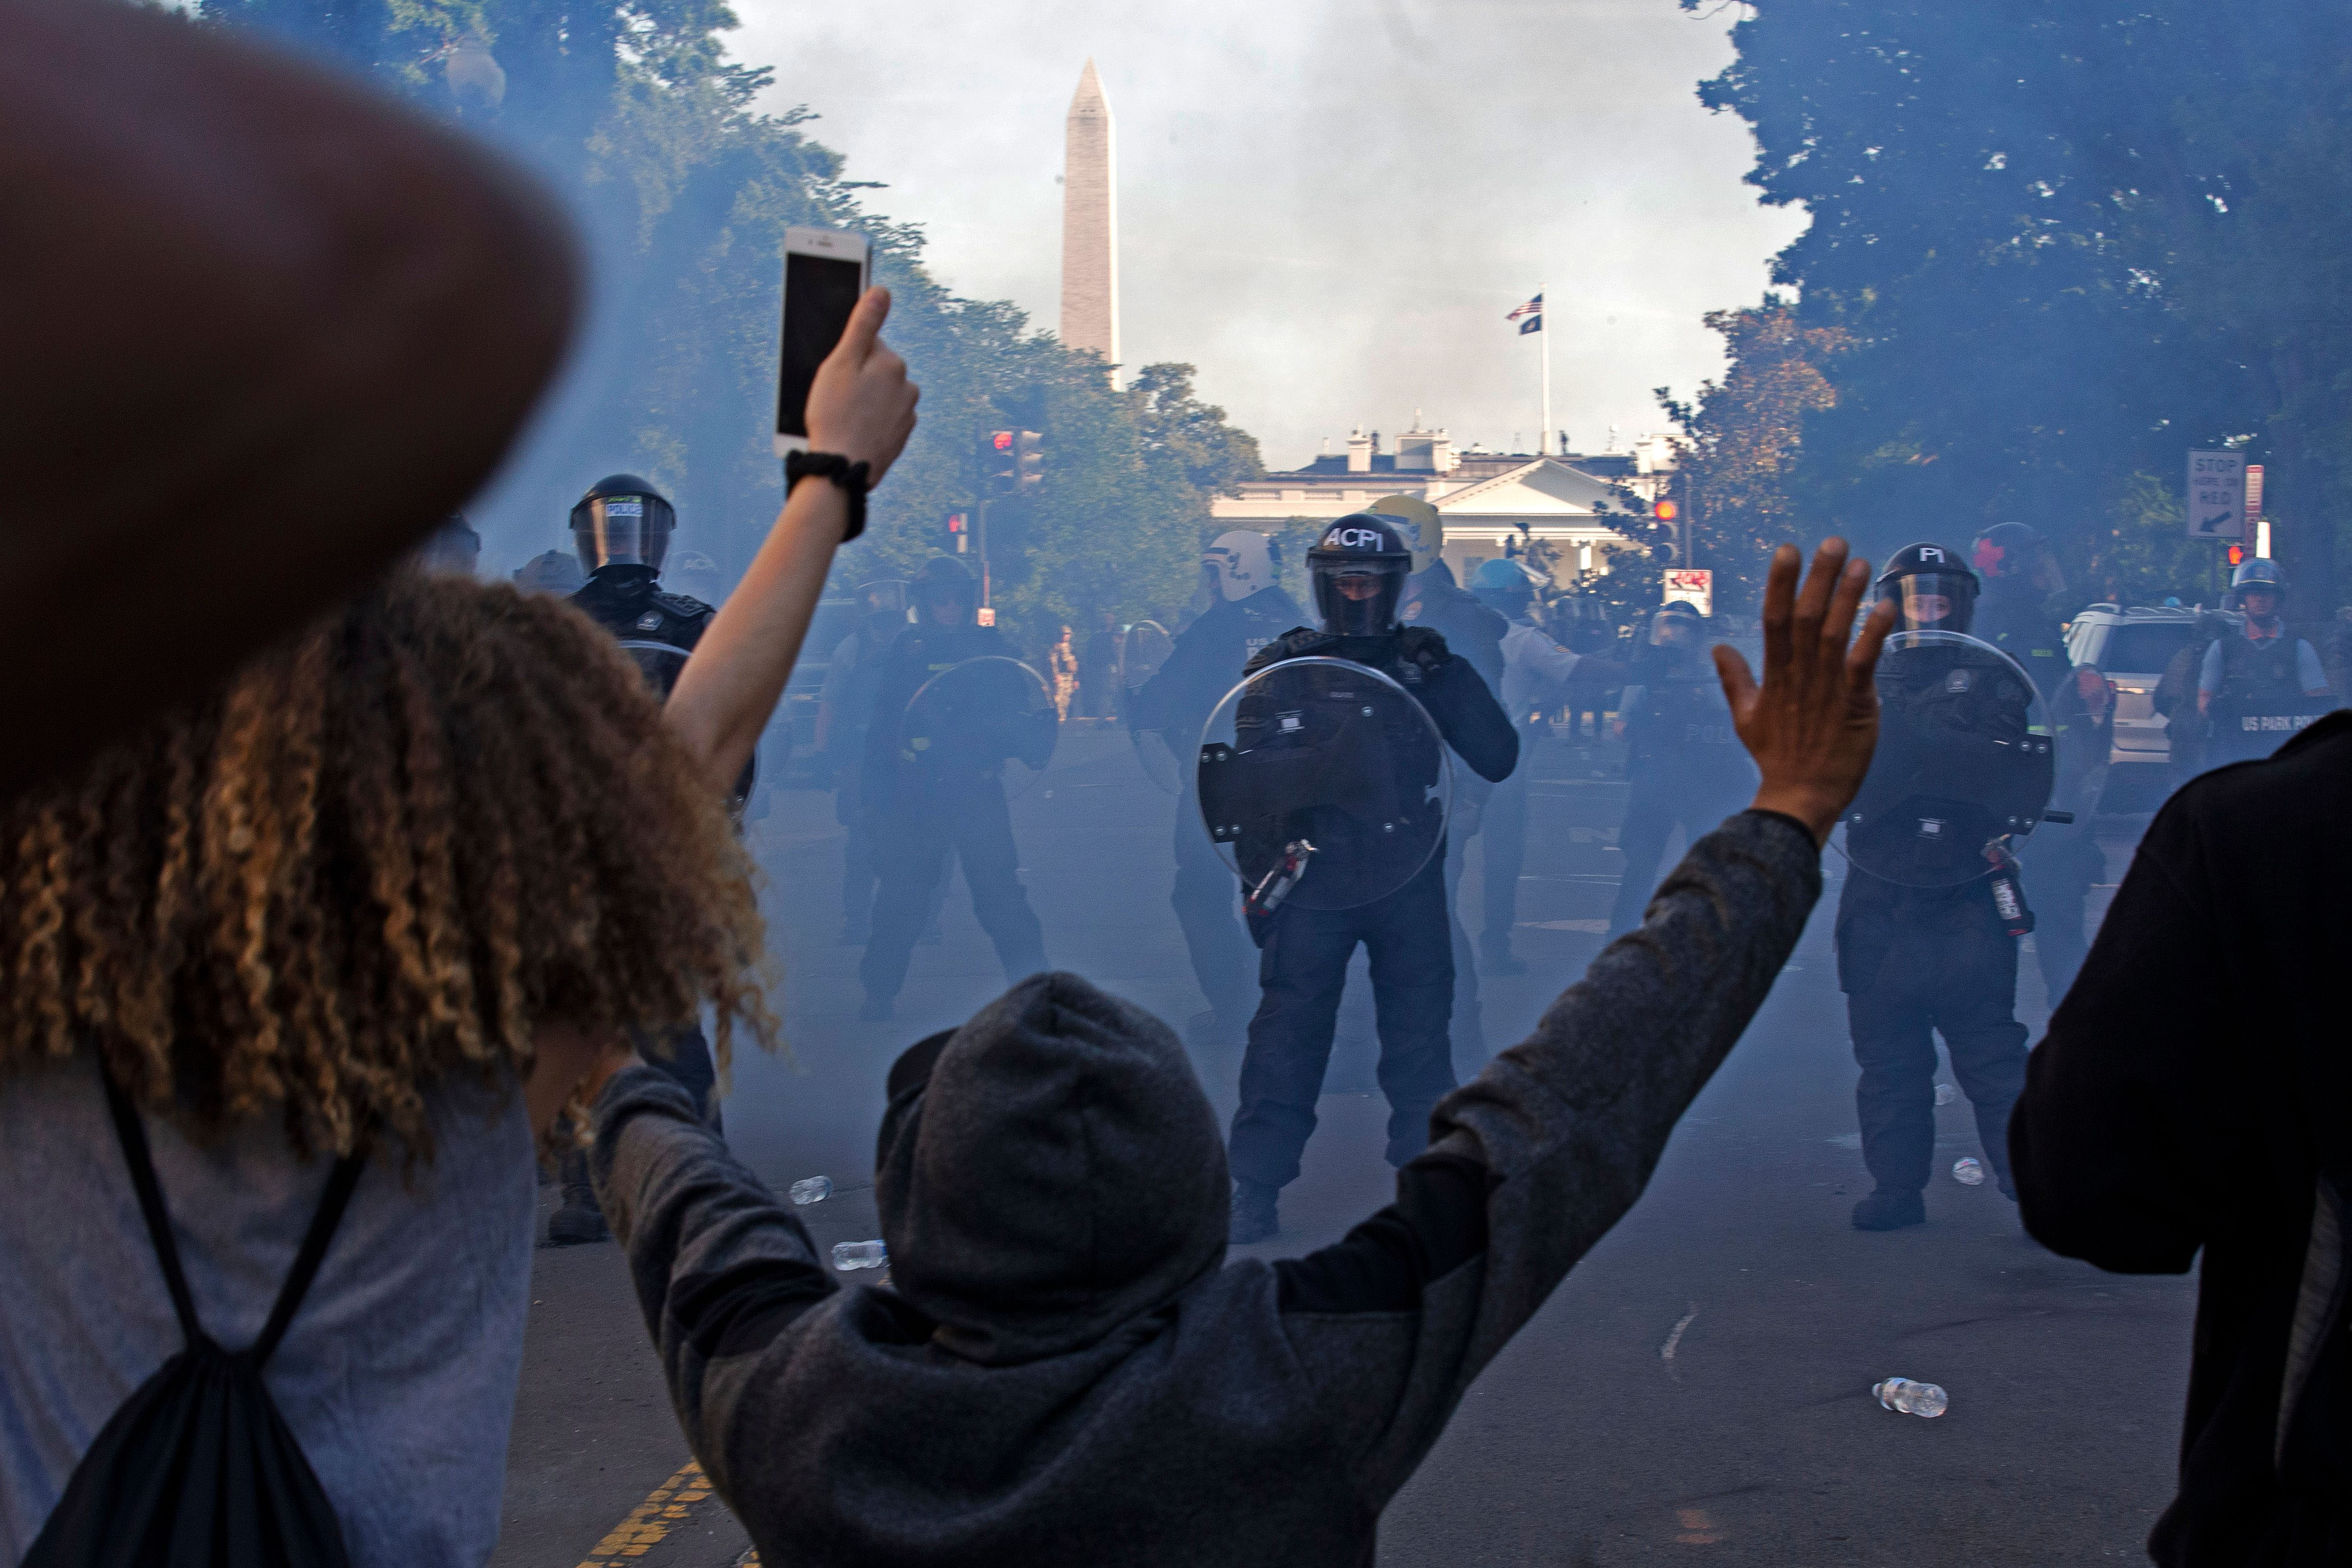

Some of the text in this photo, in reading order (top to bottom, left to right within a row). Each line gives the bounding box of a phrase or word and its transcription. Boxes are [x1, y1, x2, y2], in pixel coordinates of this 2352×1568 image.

[2195, 458, 2236, 472] STOP
[2200, 491, 2231, 504] RED
[608, 504, 642, 515] POLICE
[2242, 716, 2259, 731] US
[2260, 716, 2292, 730] PARK
